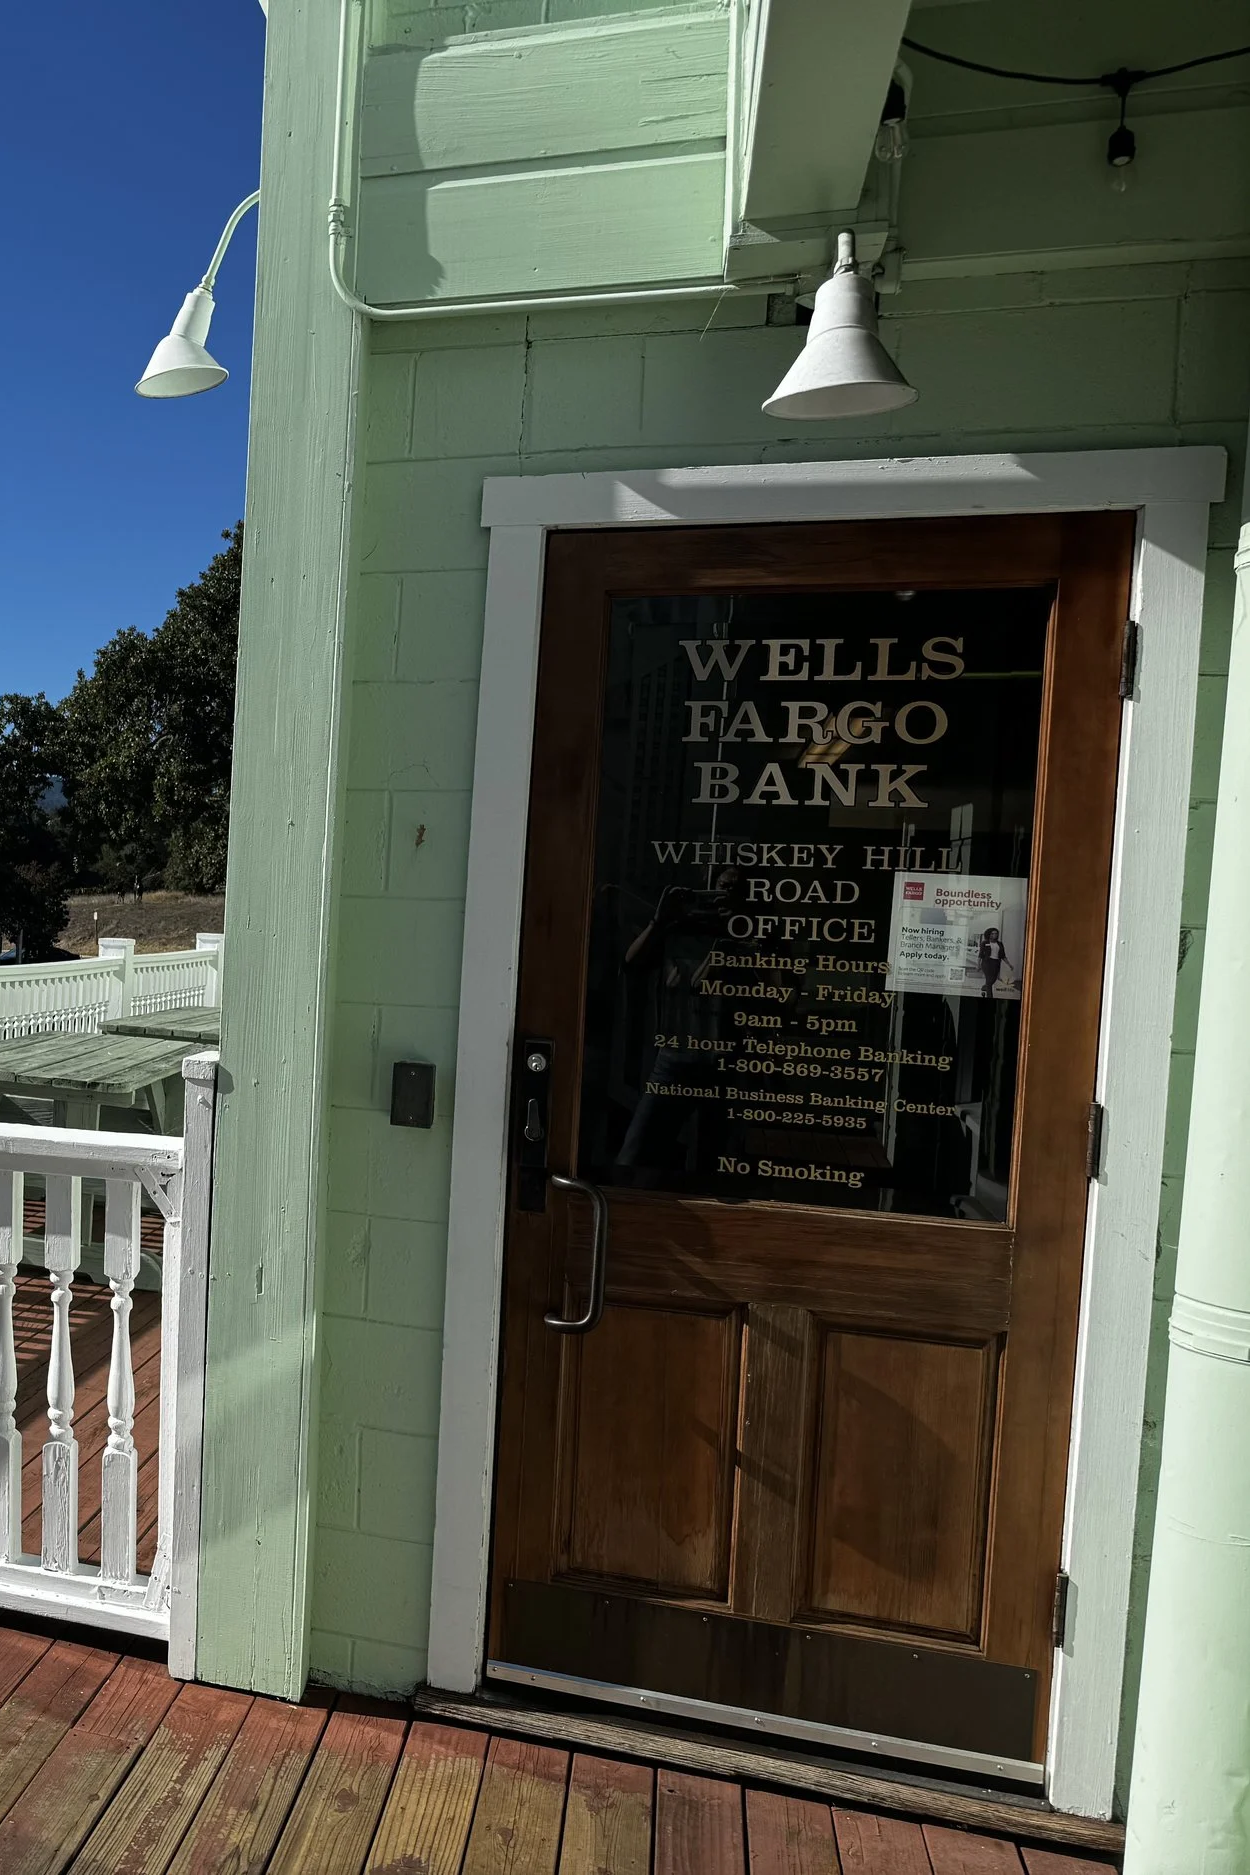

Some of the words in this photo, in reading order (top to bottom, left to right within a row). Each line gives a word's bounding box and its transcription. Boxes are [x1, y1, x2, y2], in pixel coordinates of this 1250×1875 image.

[679, 636, 965, 682] WELLS
[681, 700, 948, 745] FARGO
[692, 762, 928, 808] BANK
[651, 841, 844, 868] WHISKEY
[862, 845, 963, 872] HILL
[746, 878, 860, 904] ROAD
[936, 888, 992, 899] Boundless
[935, 898, 1002, 910] opportunity
[728, 915, 876, 943] OFFICE
[901, 934, 925, 942] Tellers,
[921, 928, 945, 936] hiring
[899, 951, 923, 959] Apply
[924, 952, 949, 961] today.
[925, 943, 960, 952] Managers
[709, 951, 809, 974] Banking
[816, 955, 893, 975] Hours
[700, 979, 794, 1001] Monday
[816, 985, 895, 1008] Friday
[733, 1011, 782, 1028] 9am
[806, 1015, 857, 1033] 5pm
[654, 1034, 680, 1048] 24
[687, 1035, 736, 1052] hour
[743, 1036, 851, 1061] Telephone
[858, 1046, 953, 1071] Banking
[717, 1058, 884, 1082] 1-800-869-3557
[645, 1082, 720, 1099] National
[726, 1086, 804, 1105] Business
[810, 1092, 887, 1114] Banking
[893, 1098, 955, 1116] Center
[727, 1108, 867, 1129] 1-800-225-5935
[717, 1156, 750, 1175] No
[757, 1160, 865, 1188] Smoking
